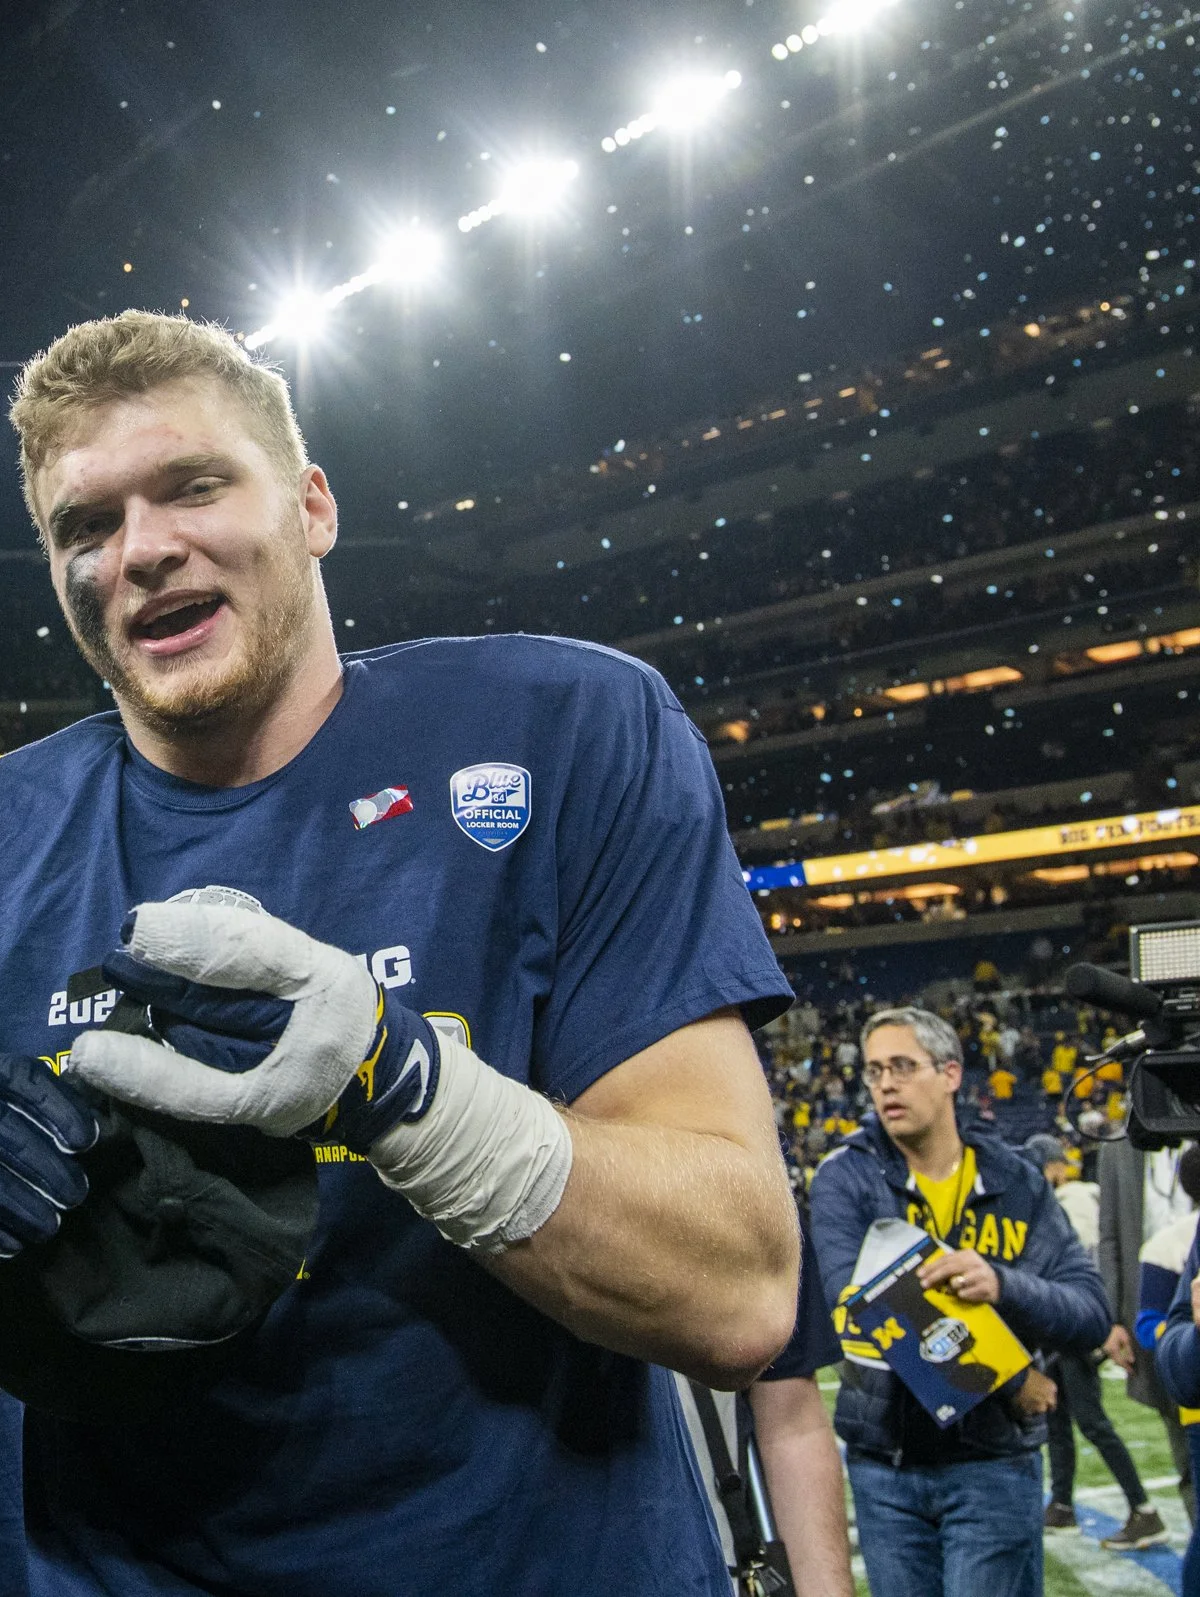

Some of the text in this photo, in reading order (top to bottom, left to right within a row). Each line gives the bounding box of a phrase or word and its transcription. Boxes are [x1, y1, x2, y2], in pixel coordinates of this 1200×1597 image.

[464, 809, 521, 820] OFFICIAL
[466, 821, 495, 829] LOCKER
[48, 987, 124, 1027] 202
